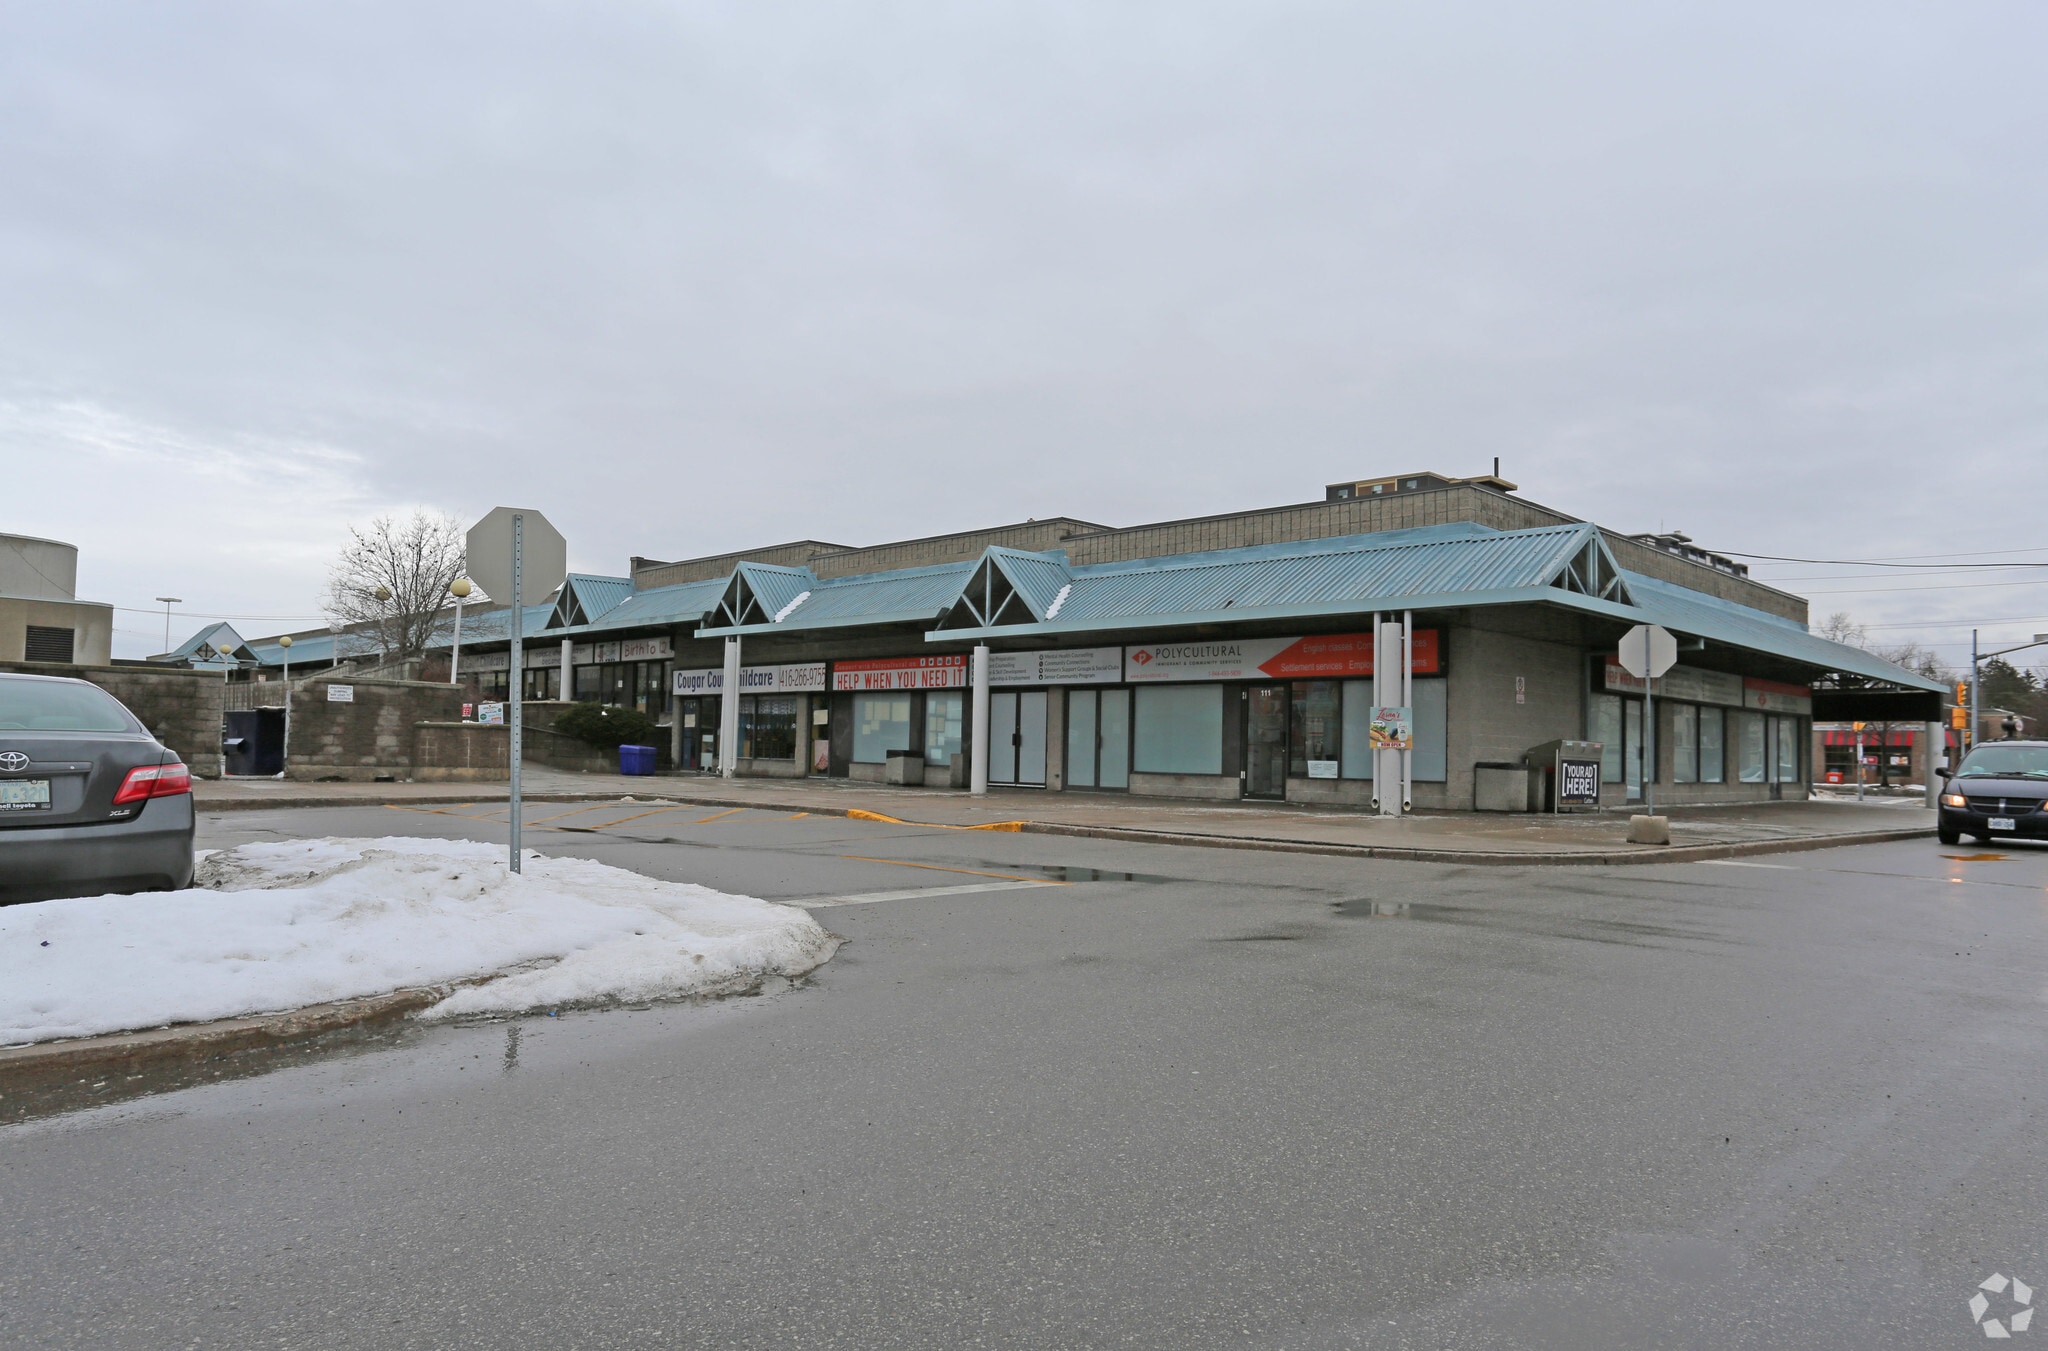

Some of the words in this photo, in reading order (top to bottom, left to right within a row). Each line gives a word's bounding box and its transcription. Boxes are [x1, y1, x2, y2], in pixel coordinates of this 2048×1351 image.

[624, 643, 644, 657] Birth
[1155, 645, 1242, 659] POLYCULTURAL
[1280, 662, 1315, 672] Settlement
[1315, 661, 1343, 670] services
[1348, 659, 1374, 671] Employ
[677, 672, 706, 692] Cougar
[780, 666, 826, 687] 416-266-9755
[837, 673, 859, 690] HELP
[864, 671, 892, 689] WHEN
[897, 671, 917, 688] YOU
[922, 669, 948, 687] NEED
[953, 668, 963, 686] IT
[1260, 689, 1271, 697] 111
[1567, 765, 1585, 777] YOUR
[1585, 766, 1593, 778] AD
[1566, 778, 1593, 795] HERE!
[109, 809, 131, 817] XLE
